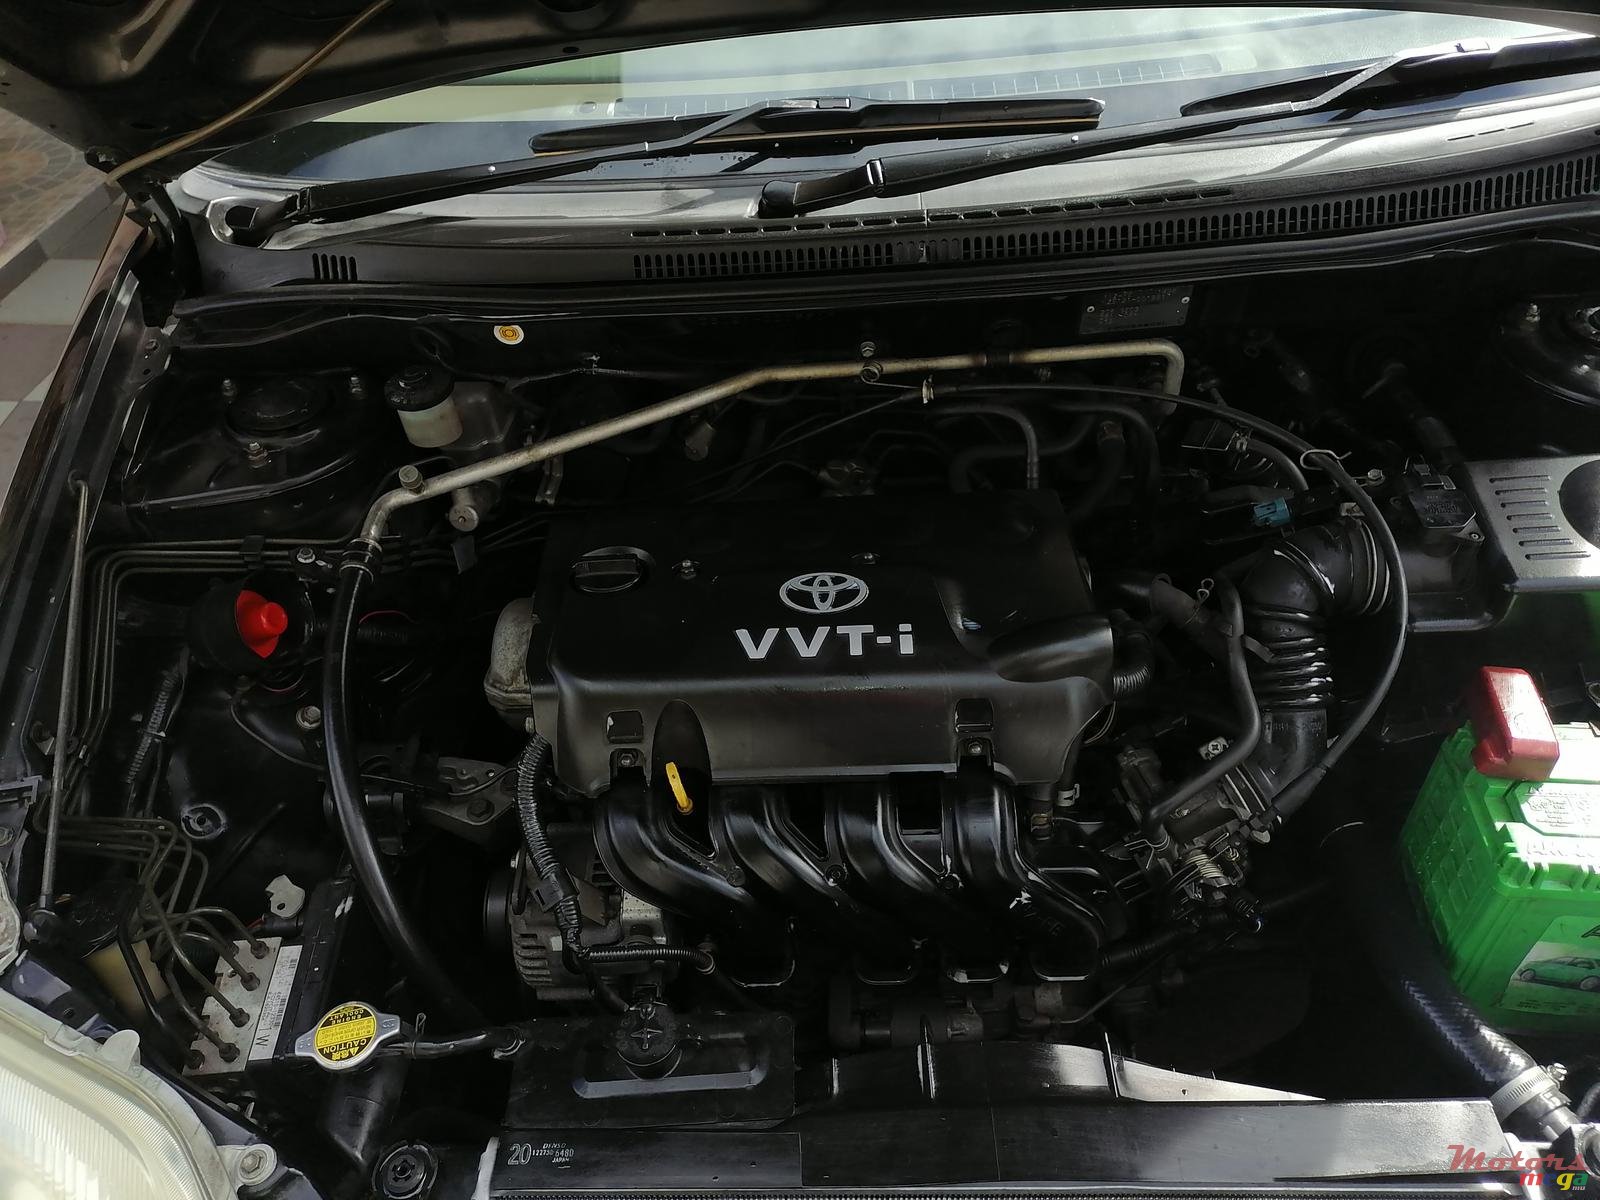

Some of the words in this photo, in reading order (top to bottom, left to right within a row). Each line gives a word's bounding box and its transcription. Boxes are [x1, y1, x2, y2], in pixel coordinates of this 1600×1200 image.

[735, 623, 914, 660] VVT-i
[331, 1014, 362, 1025] ENGINE
[323, 1038, 367, 1054] CAUTION
[507, 1143, 532, 1165] 20
